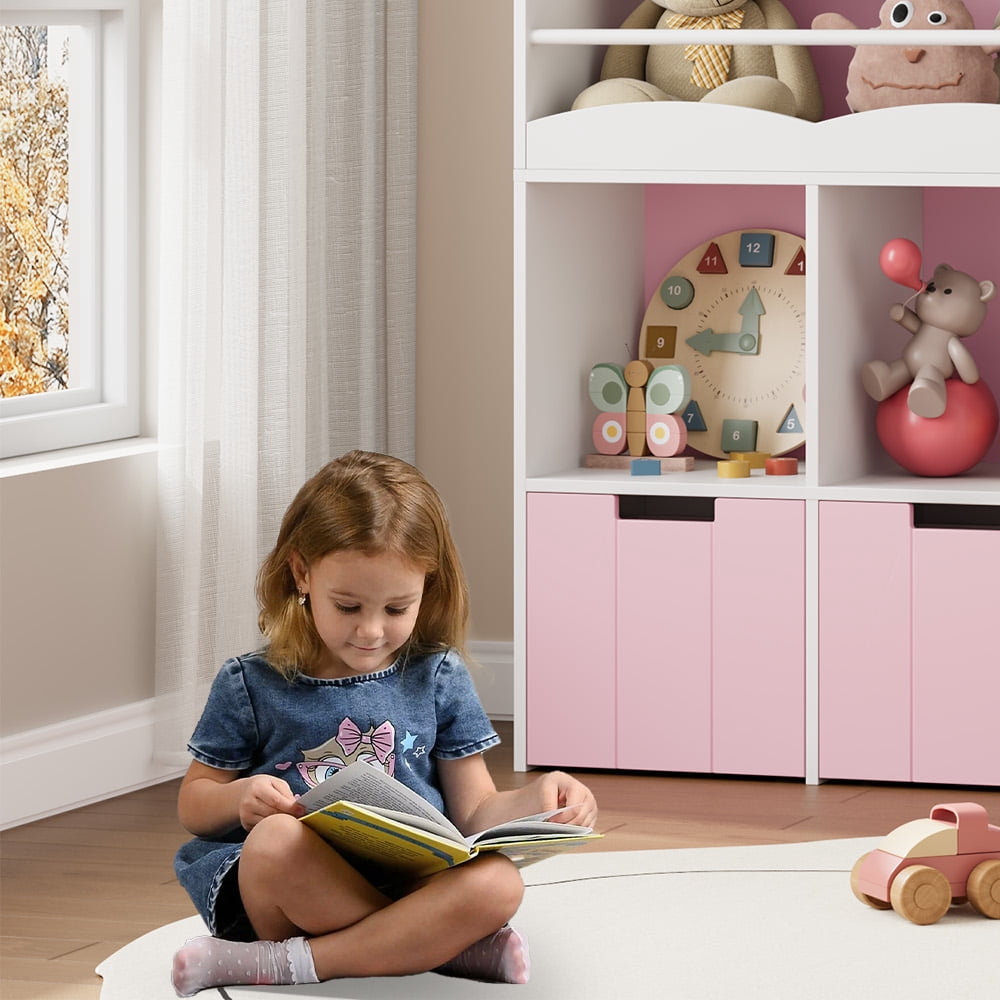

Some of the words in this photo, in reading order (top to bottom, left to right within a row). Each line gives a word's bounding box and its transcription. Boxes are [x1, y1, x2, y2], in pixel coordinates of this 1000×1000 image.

[746, 243, 761, 253] 12
[705, 256, 717, 266] 11
[797, 261, 804, 272] 1
[667, 285, 681, 296] 10
[656, 337, 665, 348] 9
[687, 413, 694, 423] 7
[787, 418, 795, 430] 5
[732, 430, 740, 441] 6
